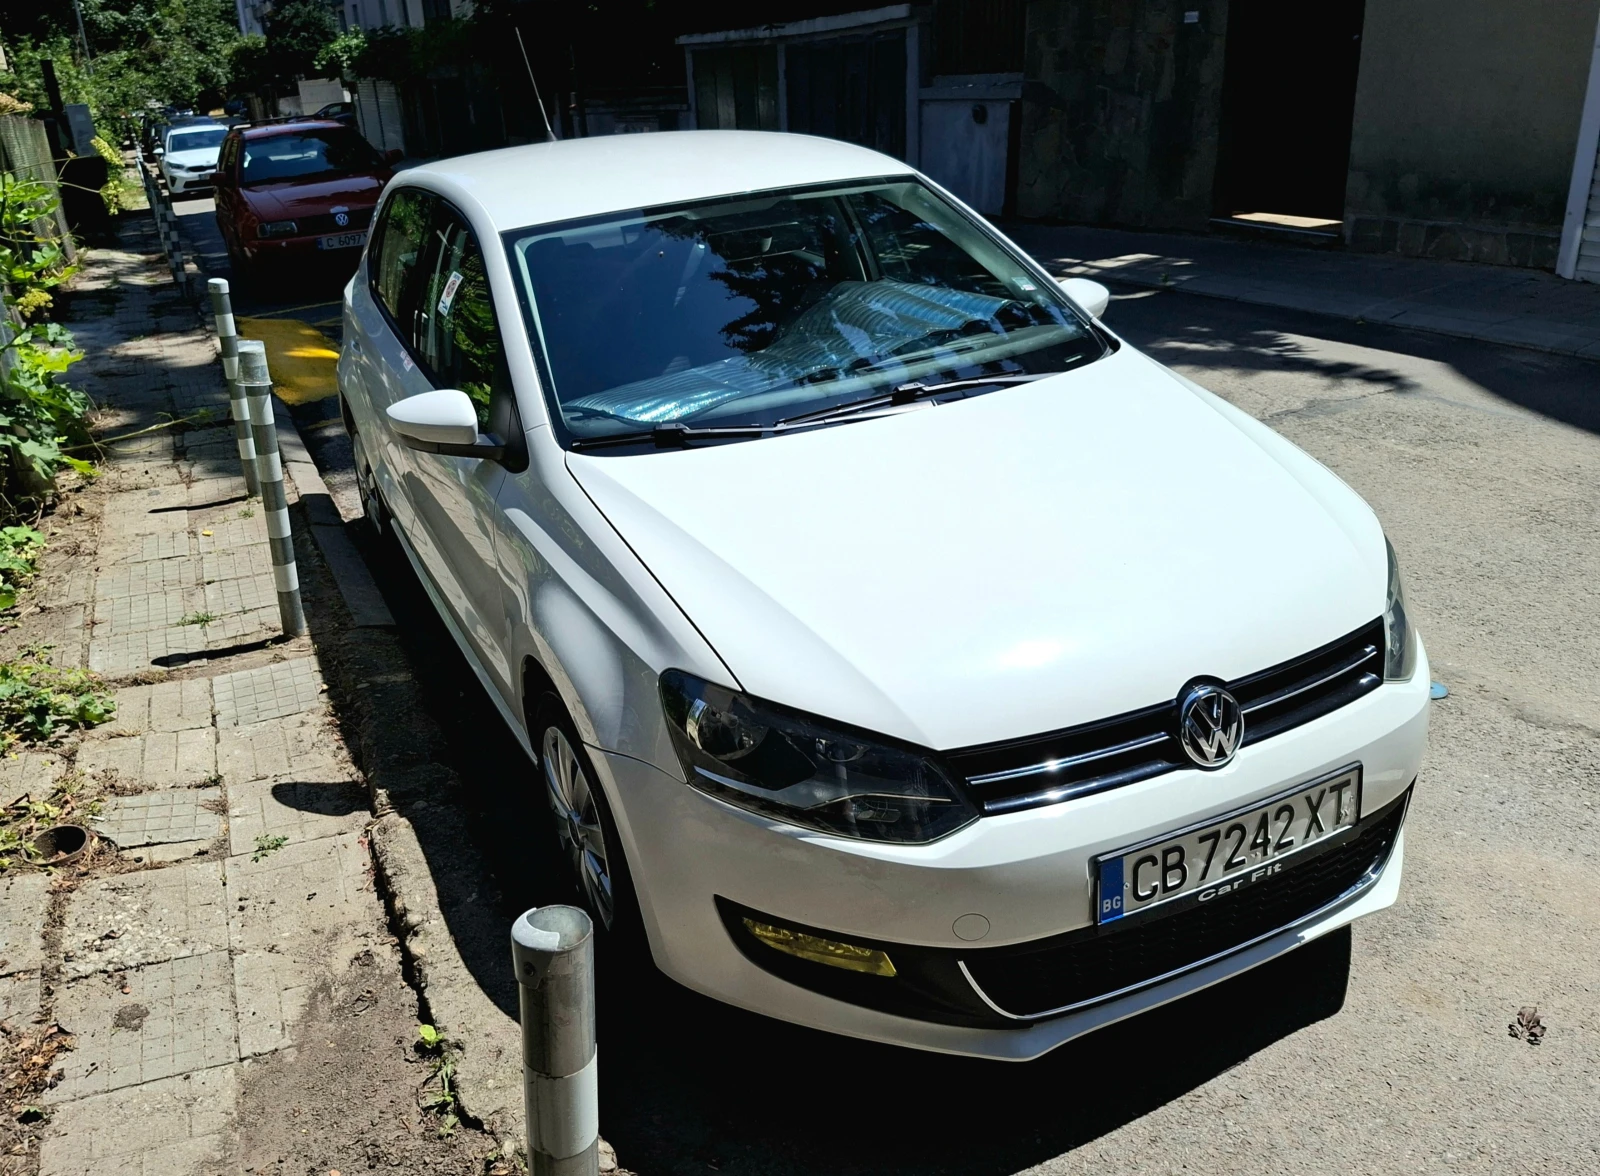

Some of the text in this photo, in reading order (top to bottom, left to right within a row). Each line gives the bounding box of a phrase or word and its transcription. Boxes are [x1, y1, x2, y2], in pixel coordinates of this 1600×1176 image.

[326, 238, 335, 248] C
[338, 234, 362, 247] 6097
[1131, 779, 1352, 902] CB 7242 XT
[1197, 862, 1282, 902] Car Fit
[1103, 895, 1121, 913] BG
